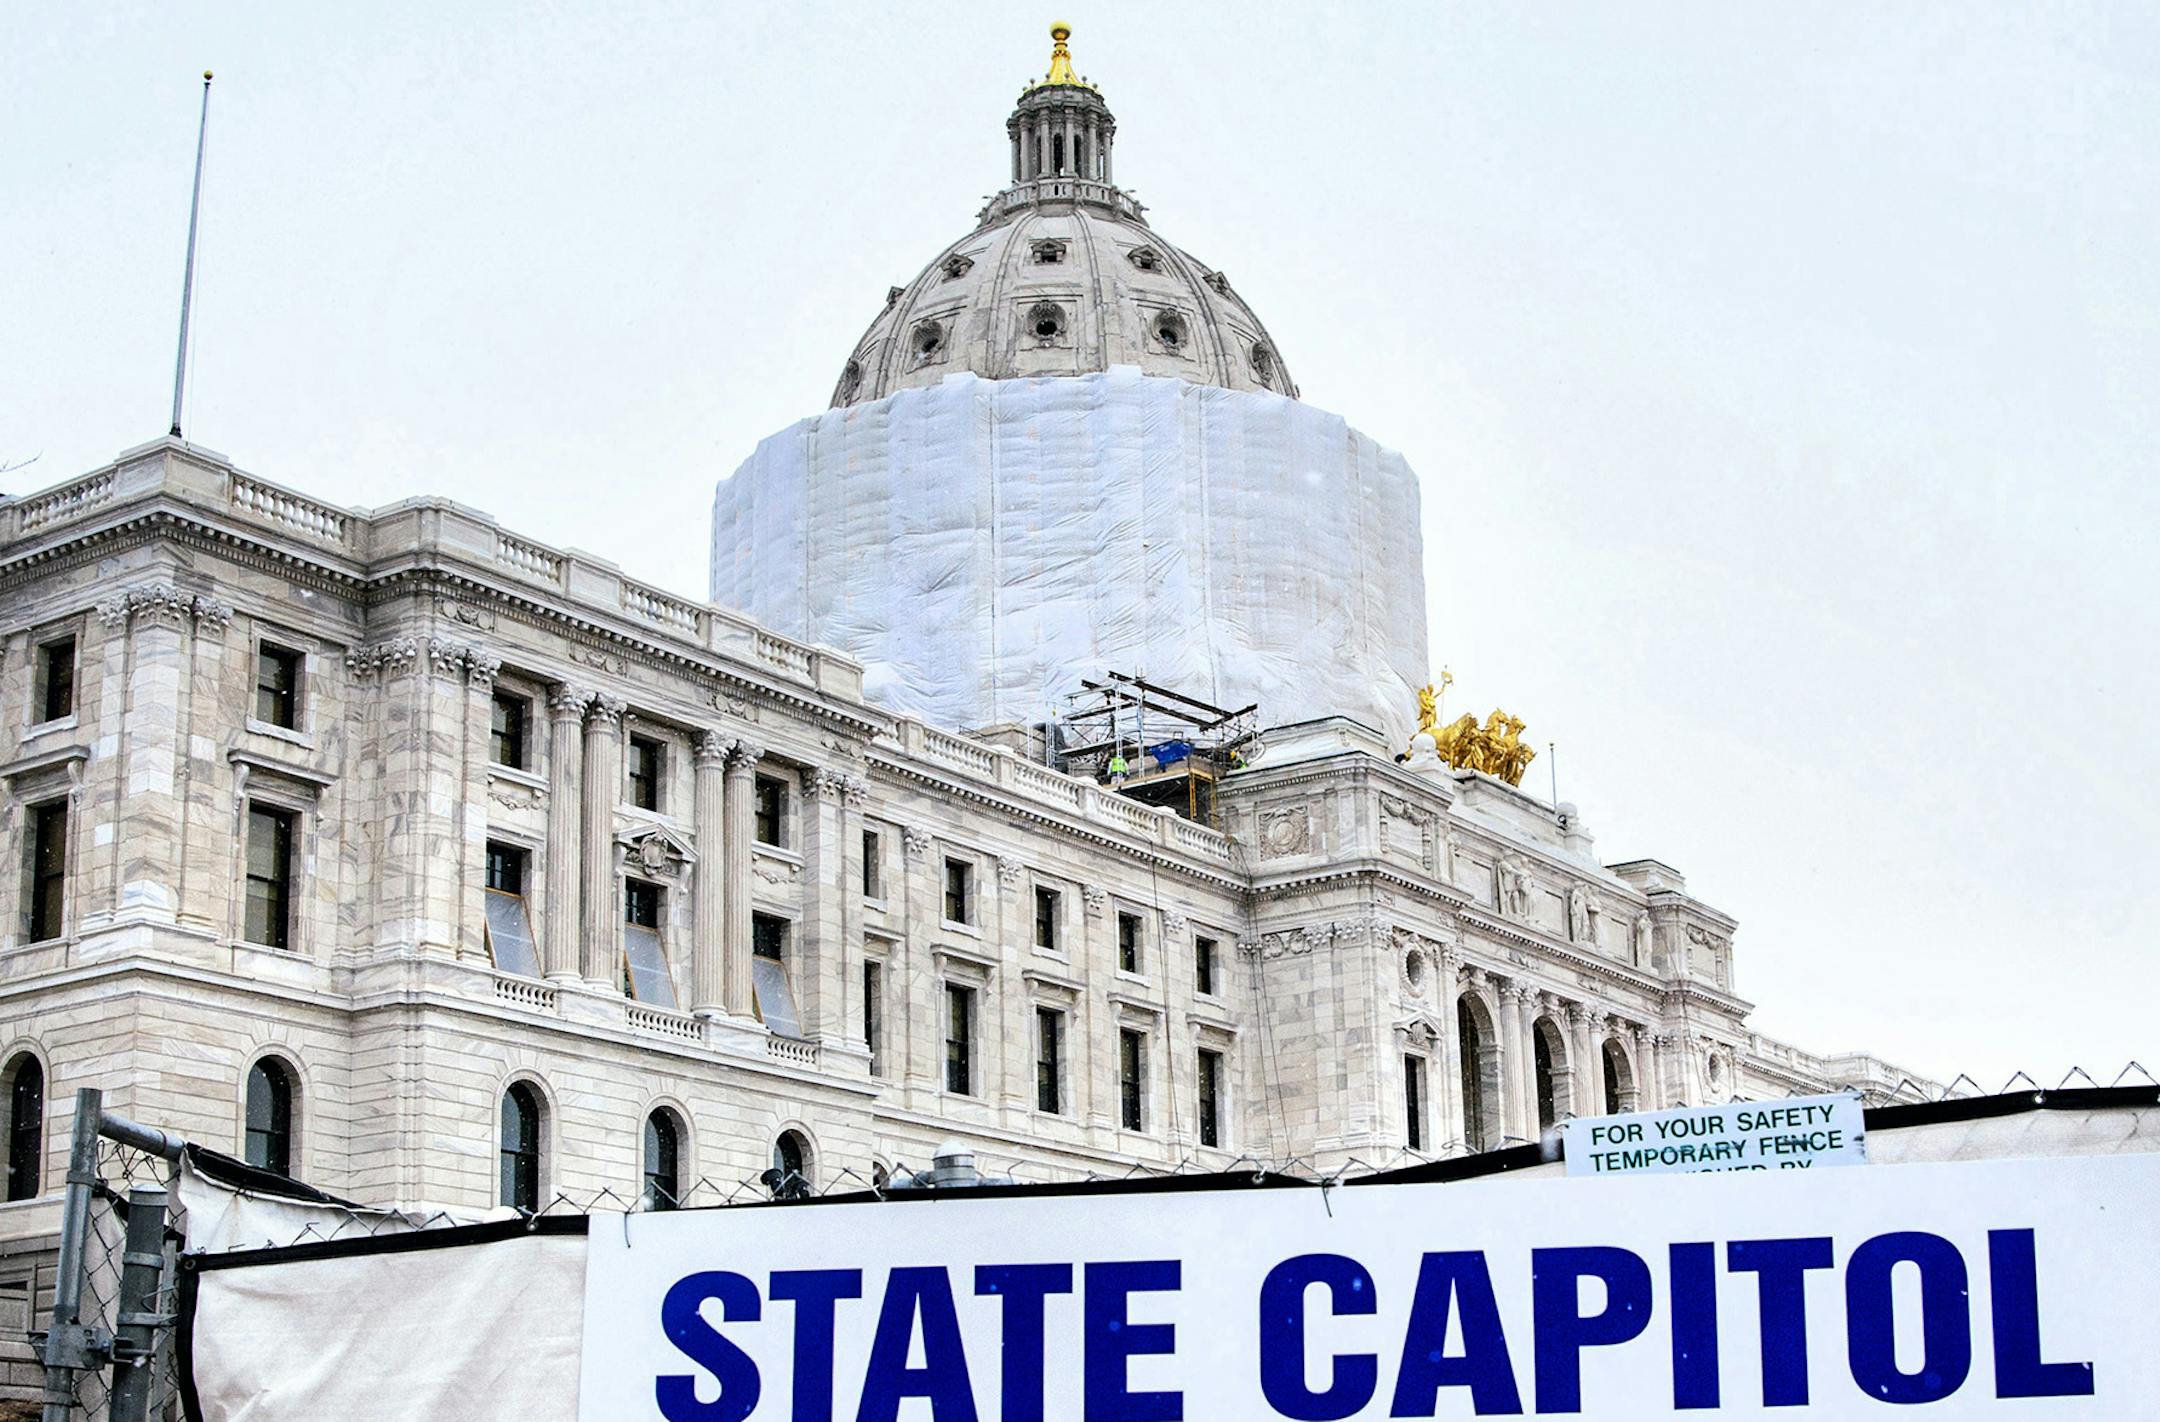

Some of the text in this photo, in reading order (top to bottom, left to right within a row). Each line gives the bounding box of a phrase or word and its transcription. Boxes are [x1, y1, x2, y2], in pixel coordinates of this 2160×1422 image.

[1592, 1105, 1834, 1145] FOR YOUR SAFETY
[1590, 1130, 1843, 1172] TEMPORARY FENCE
[655, 1228, 2095, 1422] STATE CAPITOL
